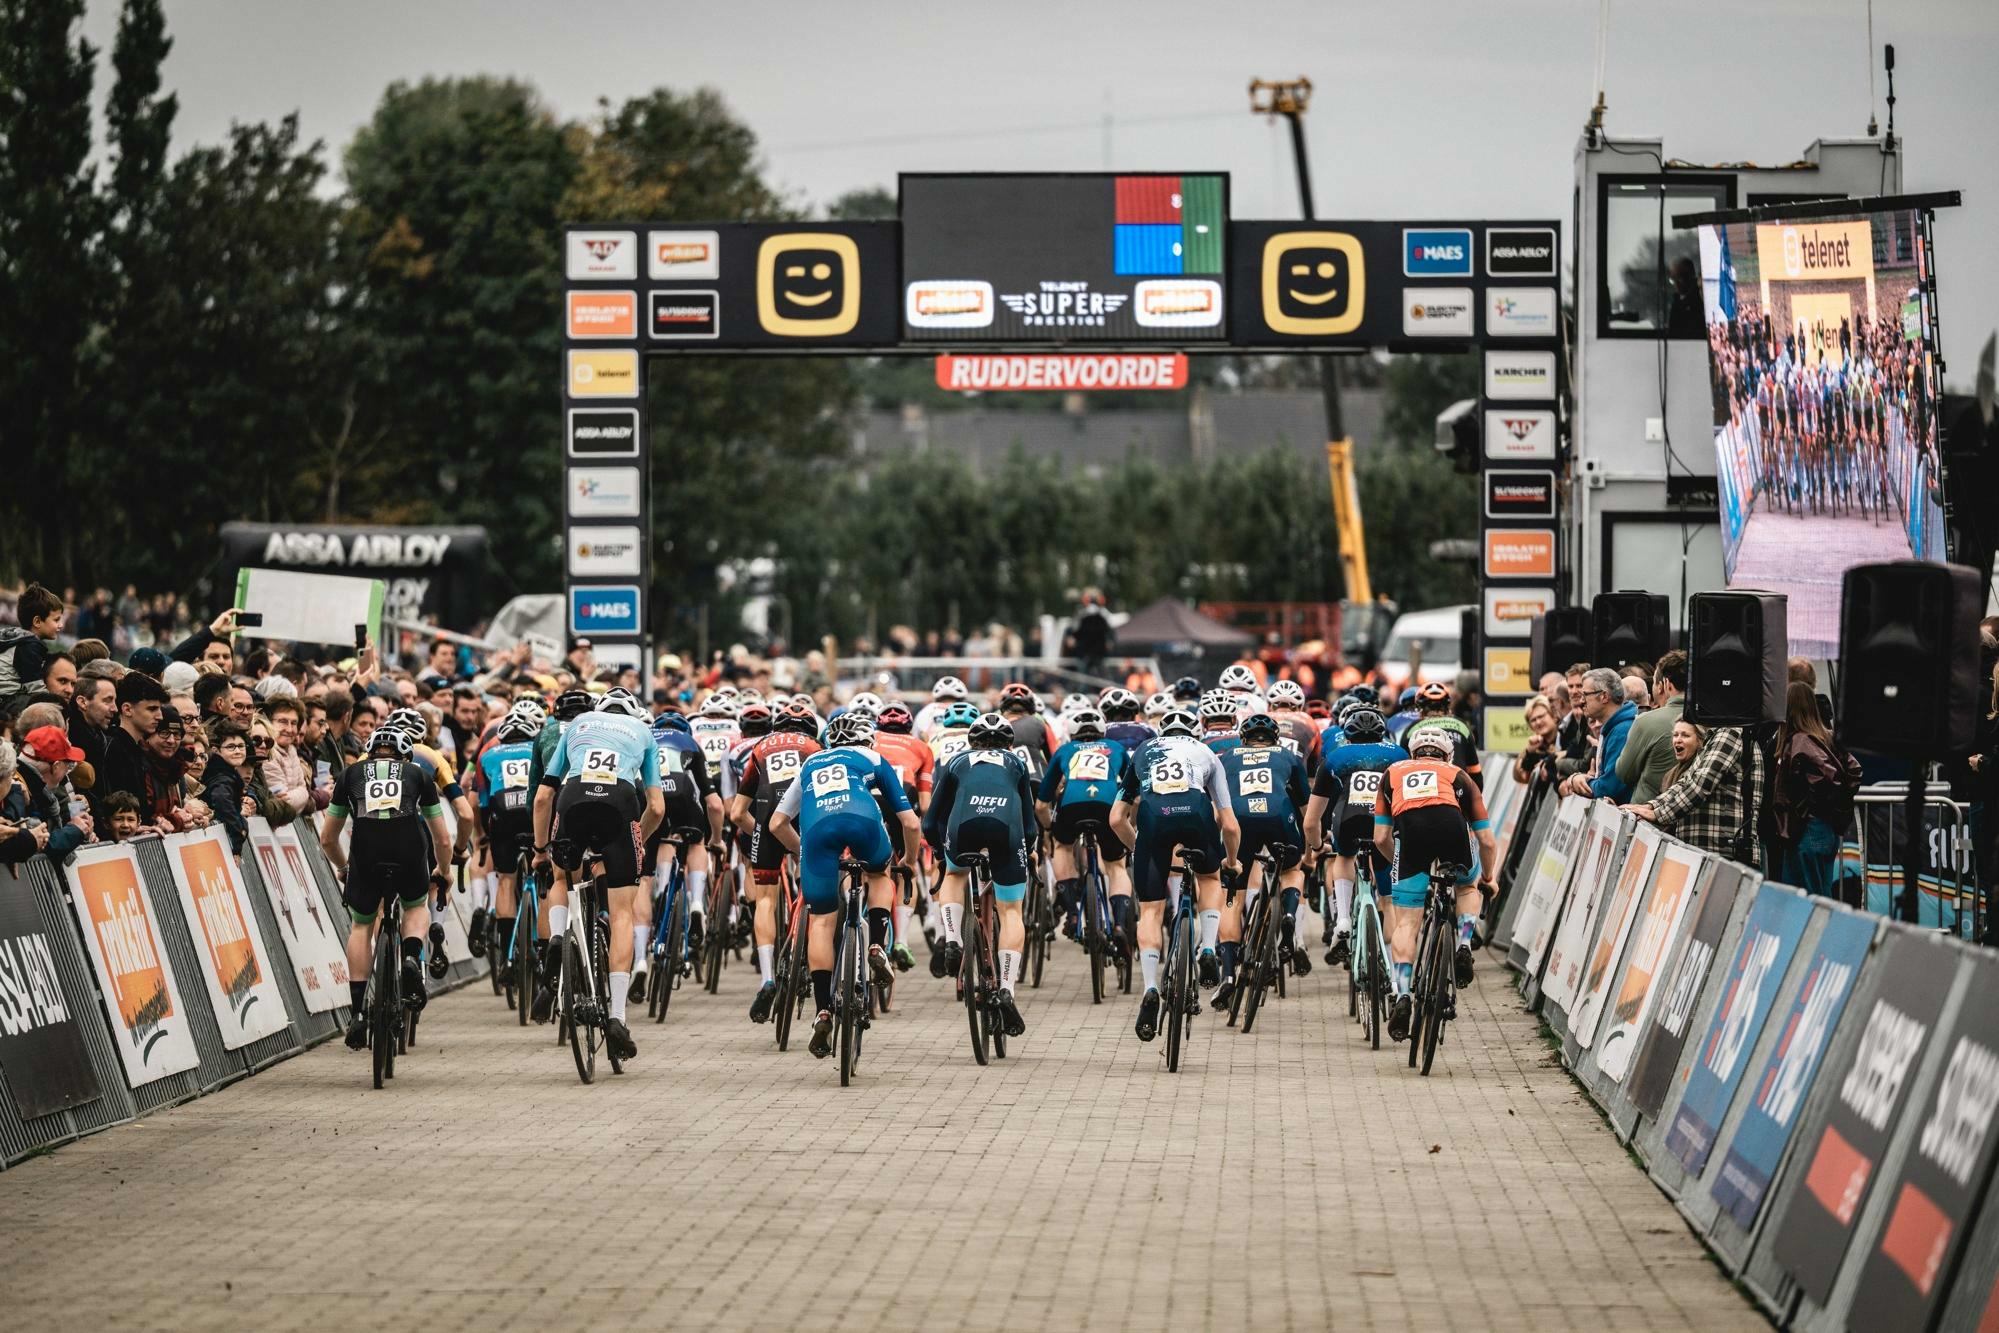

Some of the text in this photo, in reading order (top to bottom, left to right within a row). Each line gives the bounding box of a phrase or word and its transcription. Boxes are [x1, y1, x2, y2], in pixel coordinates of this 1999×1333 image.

[1424, 246, 1463, 260] MAES
[1492, 247, 1549, 259] ASSA ABLOY
[1801, 229, 1850, 269] telenet
[1024, 292, 1104, 315] SUPER
[951, 357, 1175, 387] RUDDERVOORDE
[351, 534, 450, 566] ABLOY
[590, 602, 631, 618] MAES
[705, 738, 728, 752] 48
[945, 741, 967, 754] 52
[506, 762, 529, 777] 61
[587, 751, 617, 772] 54
[770, 752, 797, 771] 55
[1083, 754, 1106, 771] 72
[816, 765, 845, 785] 65
[1155, 762, 1184, 782] 53
[1243, 769, 1270, 785] 46
[1406, 772, 1434, 788] 67
[369, 781, 399, 799] 60
[1353, 773, 1380, 792] 68
[816, 793, 850, 809] DIFFU
[824, 802, 844, 812] Sport
[969, 795, 1008, 807] DIFFU
[976, 805, 996, 815] Sport
[751, 831, 761, 864] BIKES
[16, 932, 71, 1027] ABLOY
